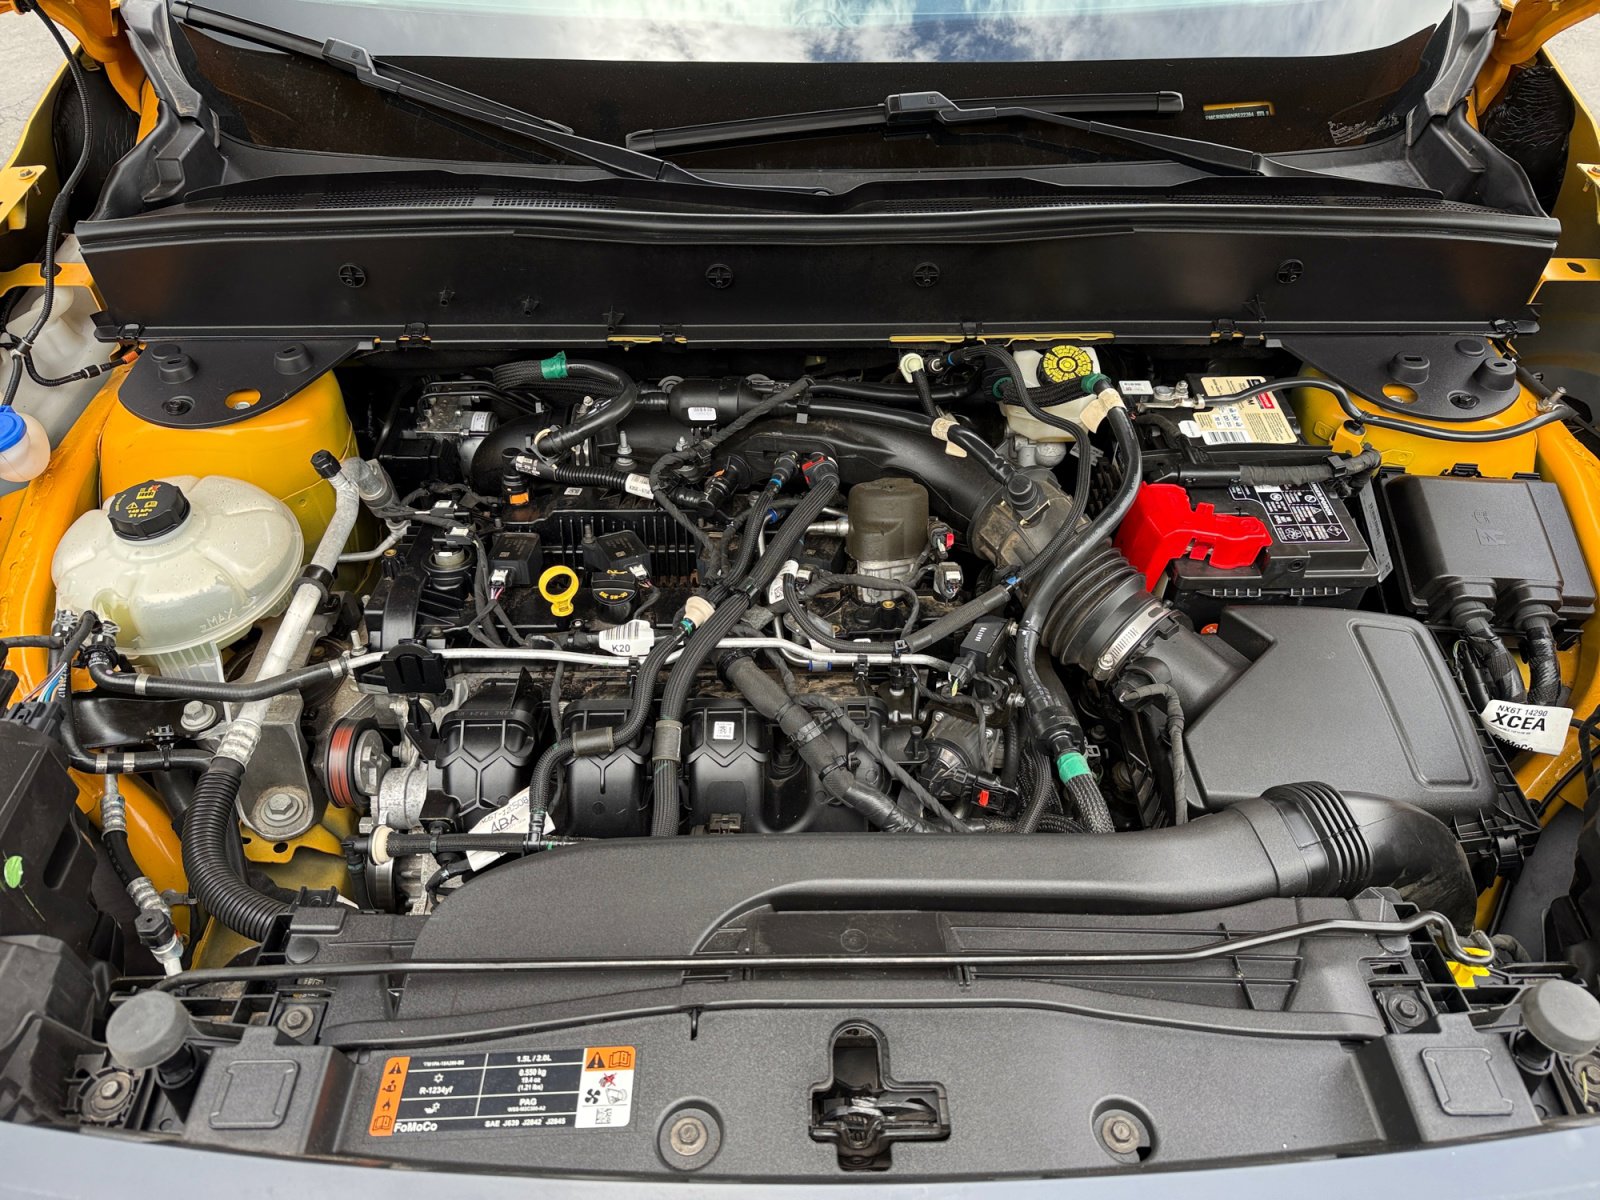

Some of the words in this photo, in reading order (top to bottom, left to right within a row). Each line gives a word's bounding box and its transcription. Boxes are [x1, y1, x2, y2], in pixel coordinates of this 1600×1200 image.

[611, 643, 631, 653] K20
[1497, 705, 1522, 715] NX6T
[1525, 709, 1548, 717] 14290
[1490, 711, 1546, 732] XCEA
[491, 814, 519, 834] ABA
[538, 1068, 547, 1078] kg
[419, 1085, 454, 1096] R-1234yf
[519, 1097, 538, 1106] PAG
[393, 1121, 438, 1133] FoMoCo
[484, 1120, 501, 1128] SAE
[502, 1119, 520, 1127] J639
